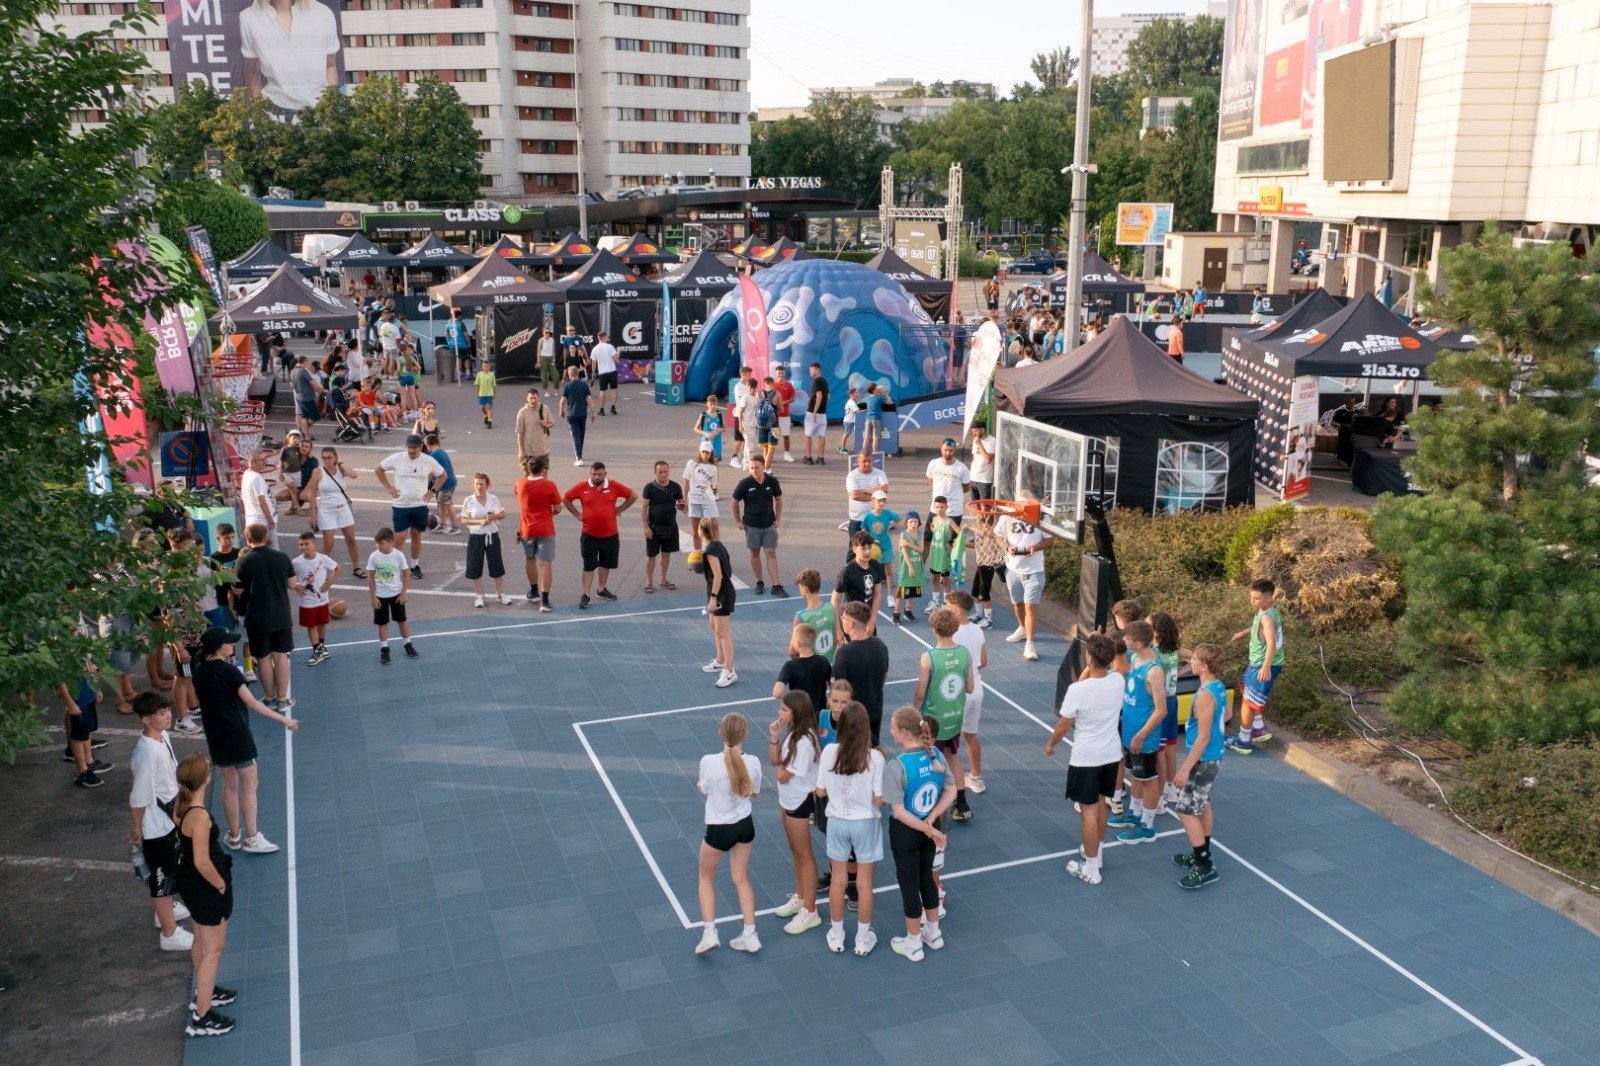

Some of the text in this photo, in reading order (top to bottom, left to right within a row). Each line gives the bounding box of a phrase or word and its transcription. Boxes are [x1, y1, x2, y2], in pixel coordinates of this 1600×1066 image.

[181, 0, 222, 26] MI
[182, 34, 228, 63] TE
[746, 176, 822, 189] LAS VEGAS
[1260, 195, 1276, 205] ALTEX
[445, 208, 500, 222] CLASS
[348, 248, 368, 256] BCR
[424, 248, 444, 256] BCR
[695, 276, 727, 285] BCR
[1082, 274, 1102, 282] CR
[493, 294, 527, 304] 3la3.ro
[605, 289, 638, 298] 3la3.ro
[262, 319, 306, 331] 3la3.ro
[622, 321, 642, 345] G
[1361, 363, 1420, 377] 3la3.ro
[933, 407, 957, 421] BCR
[820, 635, 829, 648] 11
[948, 679, 955, 693] 5
[921, 788, 933, 807] 11
